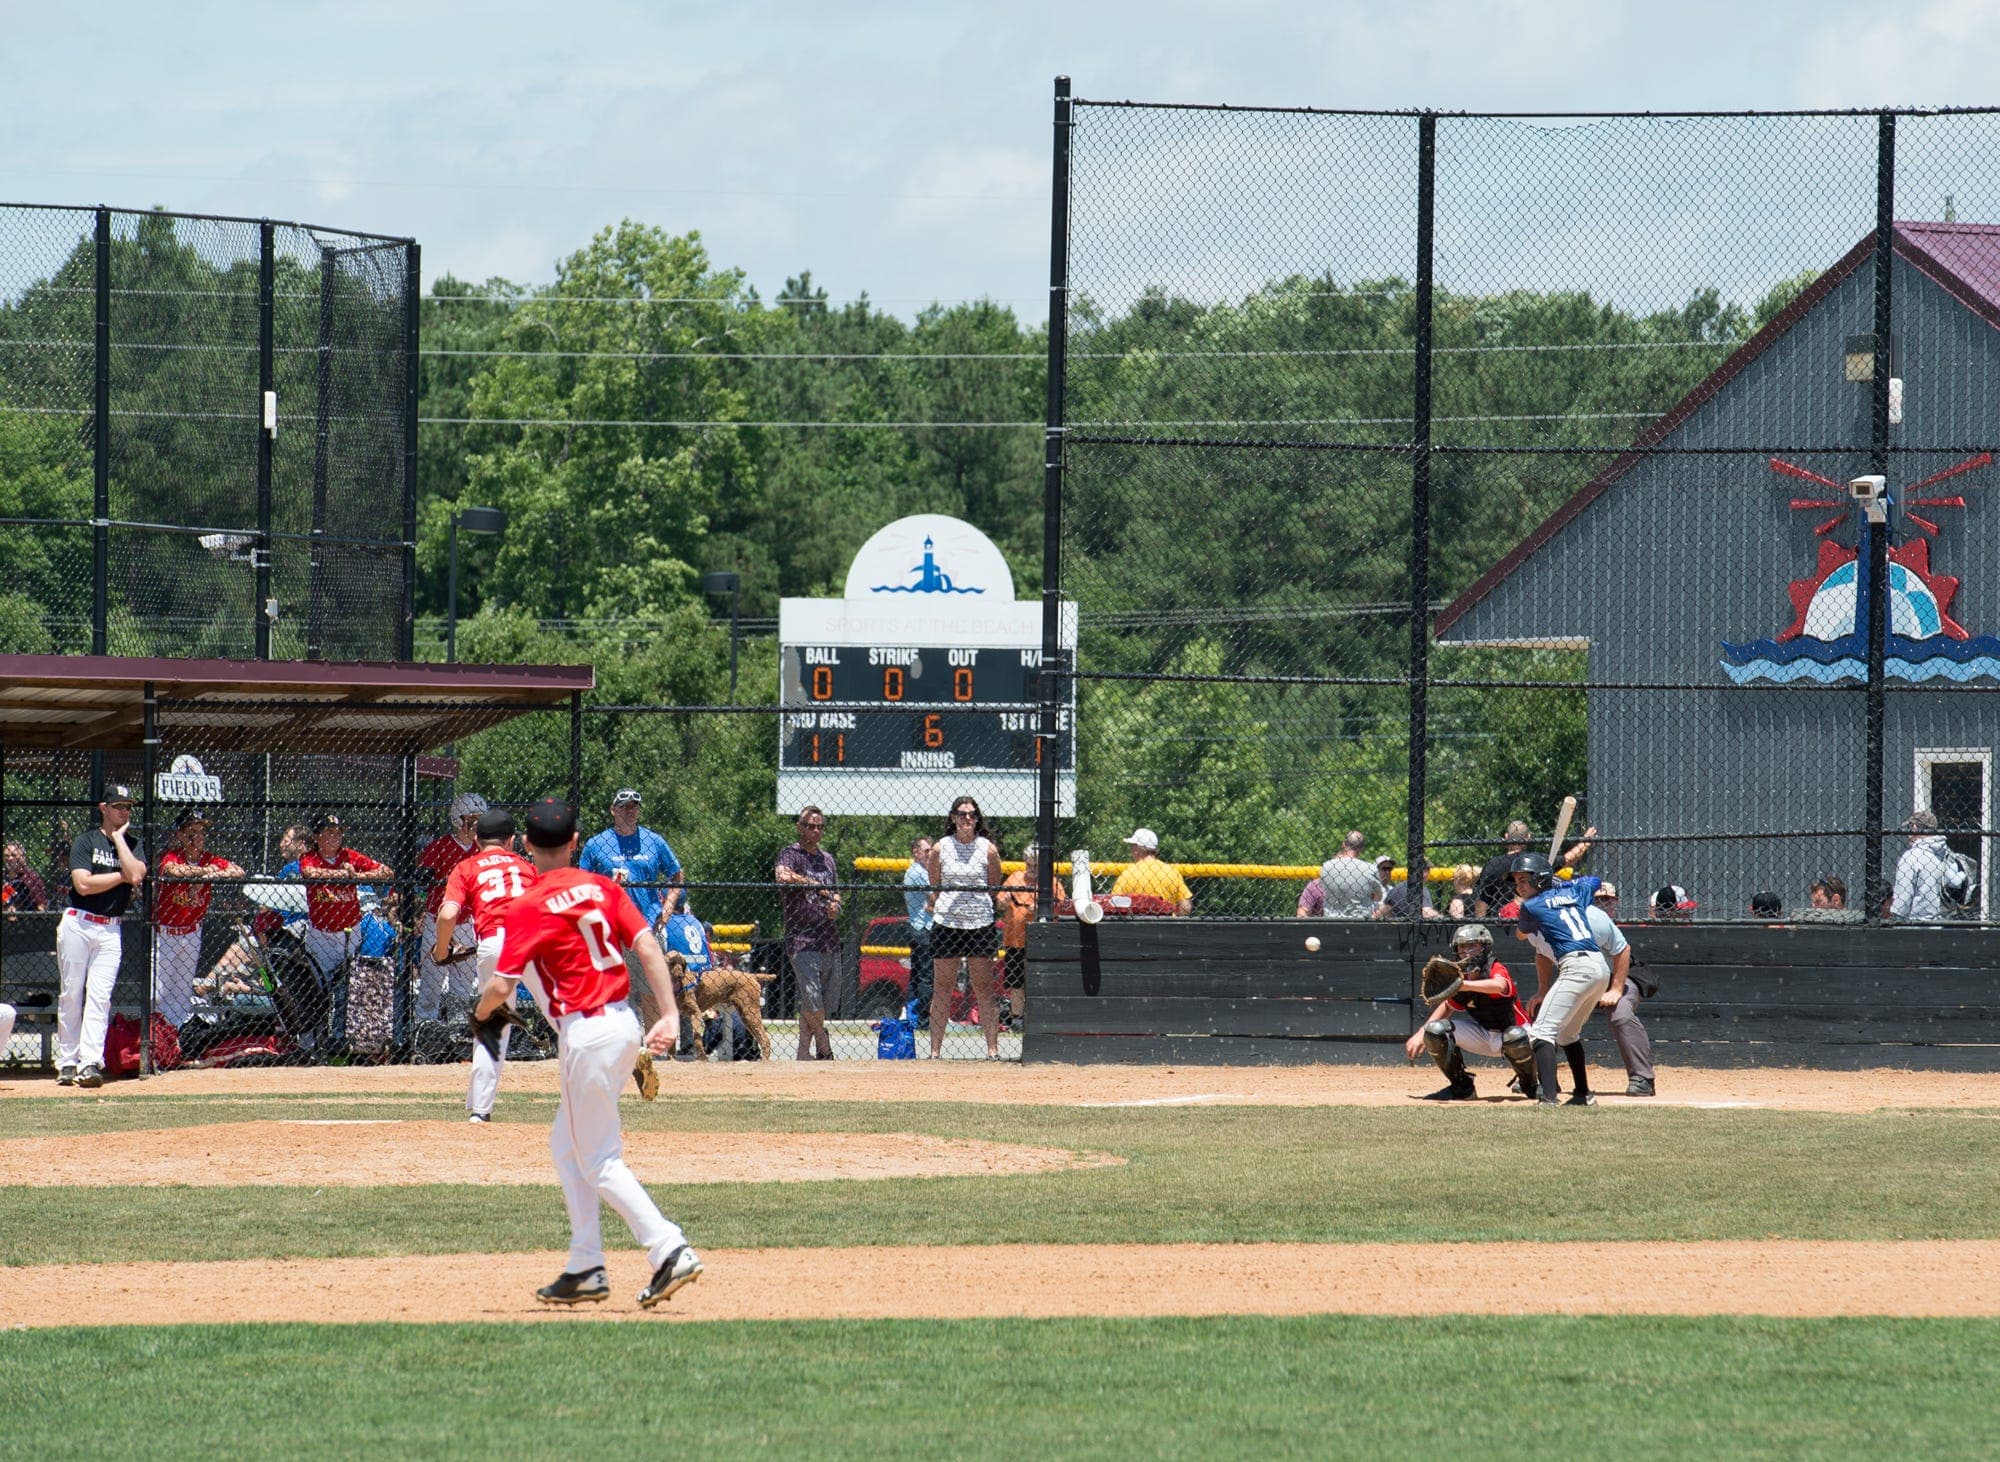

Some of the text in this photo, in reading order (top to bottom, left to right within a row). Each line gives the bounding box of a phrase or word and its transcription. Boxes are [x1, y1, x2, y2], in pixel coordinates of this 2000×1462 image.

[824, 617, 1034, 634] SPORTS AT THE BEACH
[805, 648, 840, 665] BALL
[948, 649, 979, 666] OUT
[813, 666, 832, 700] 0
[884, 667, 904, 701] 0
[954, 667, 974, 701] 0
[820, 712, 856, 729] BASE
[924, 714, 944, 748] 6
[901, 751, 955, 769] INNING
[161, 779, 217, 798] FIELD 15
[477, 865, 525, 902] 31
[576, 908, 623, 971] 0
[683, 924, 702, 954] 8
[1559, 906, 1591, 941] 11
